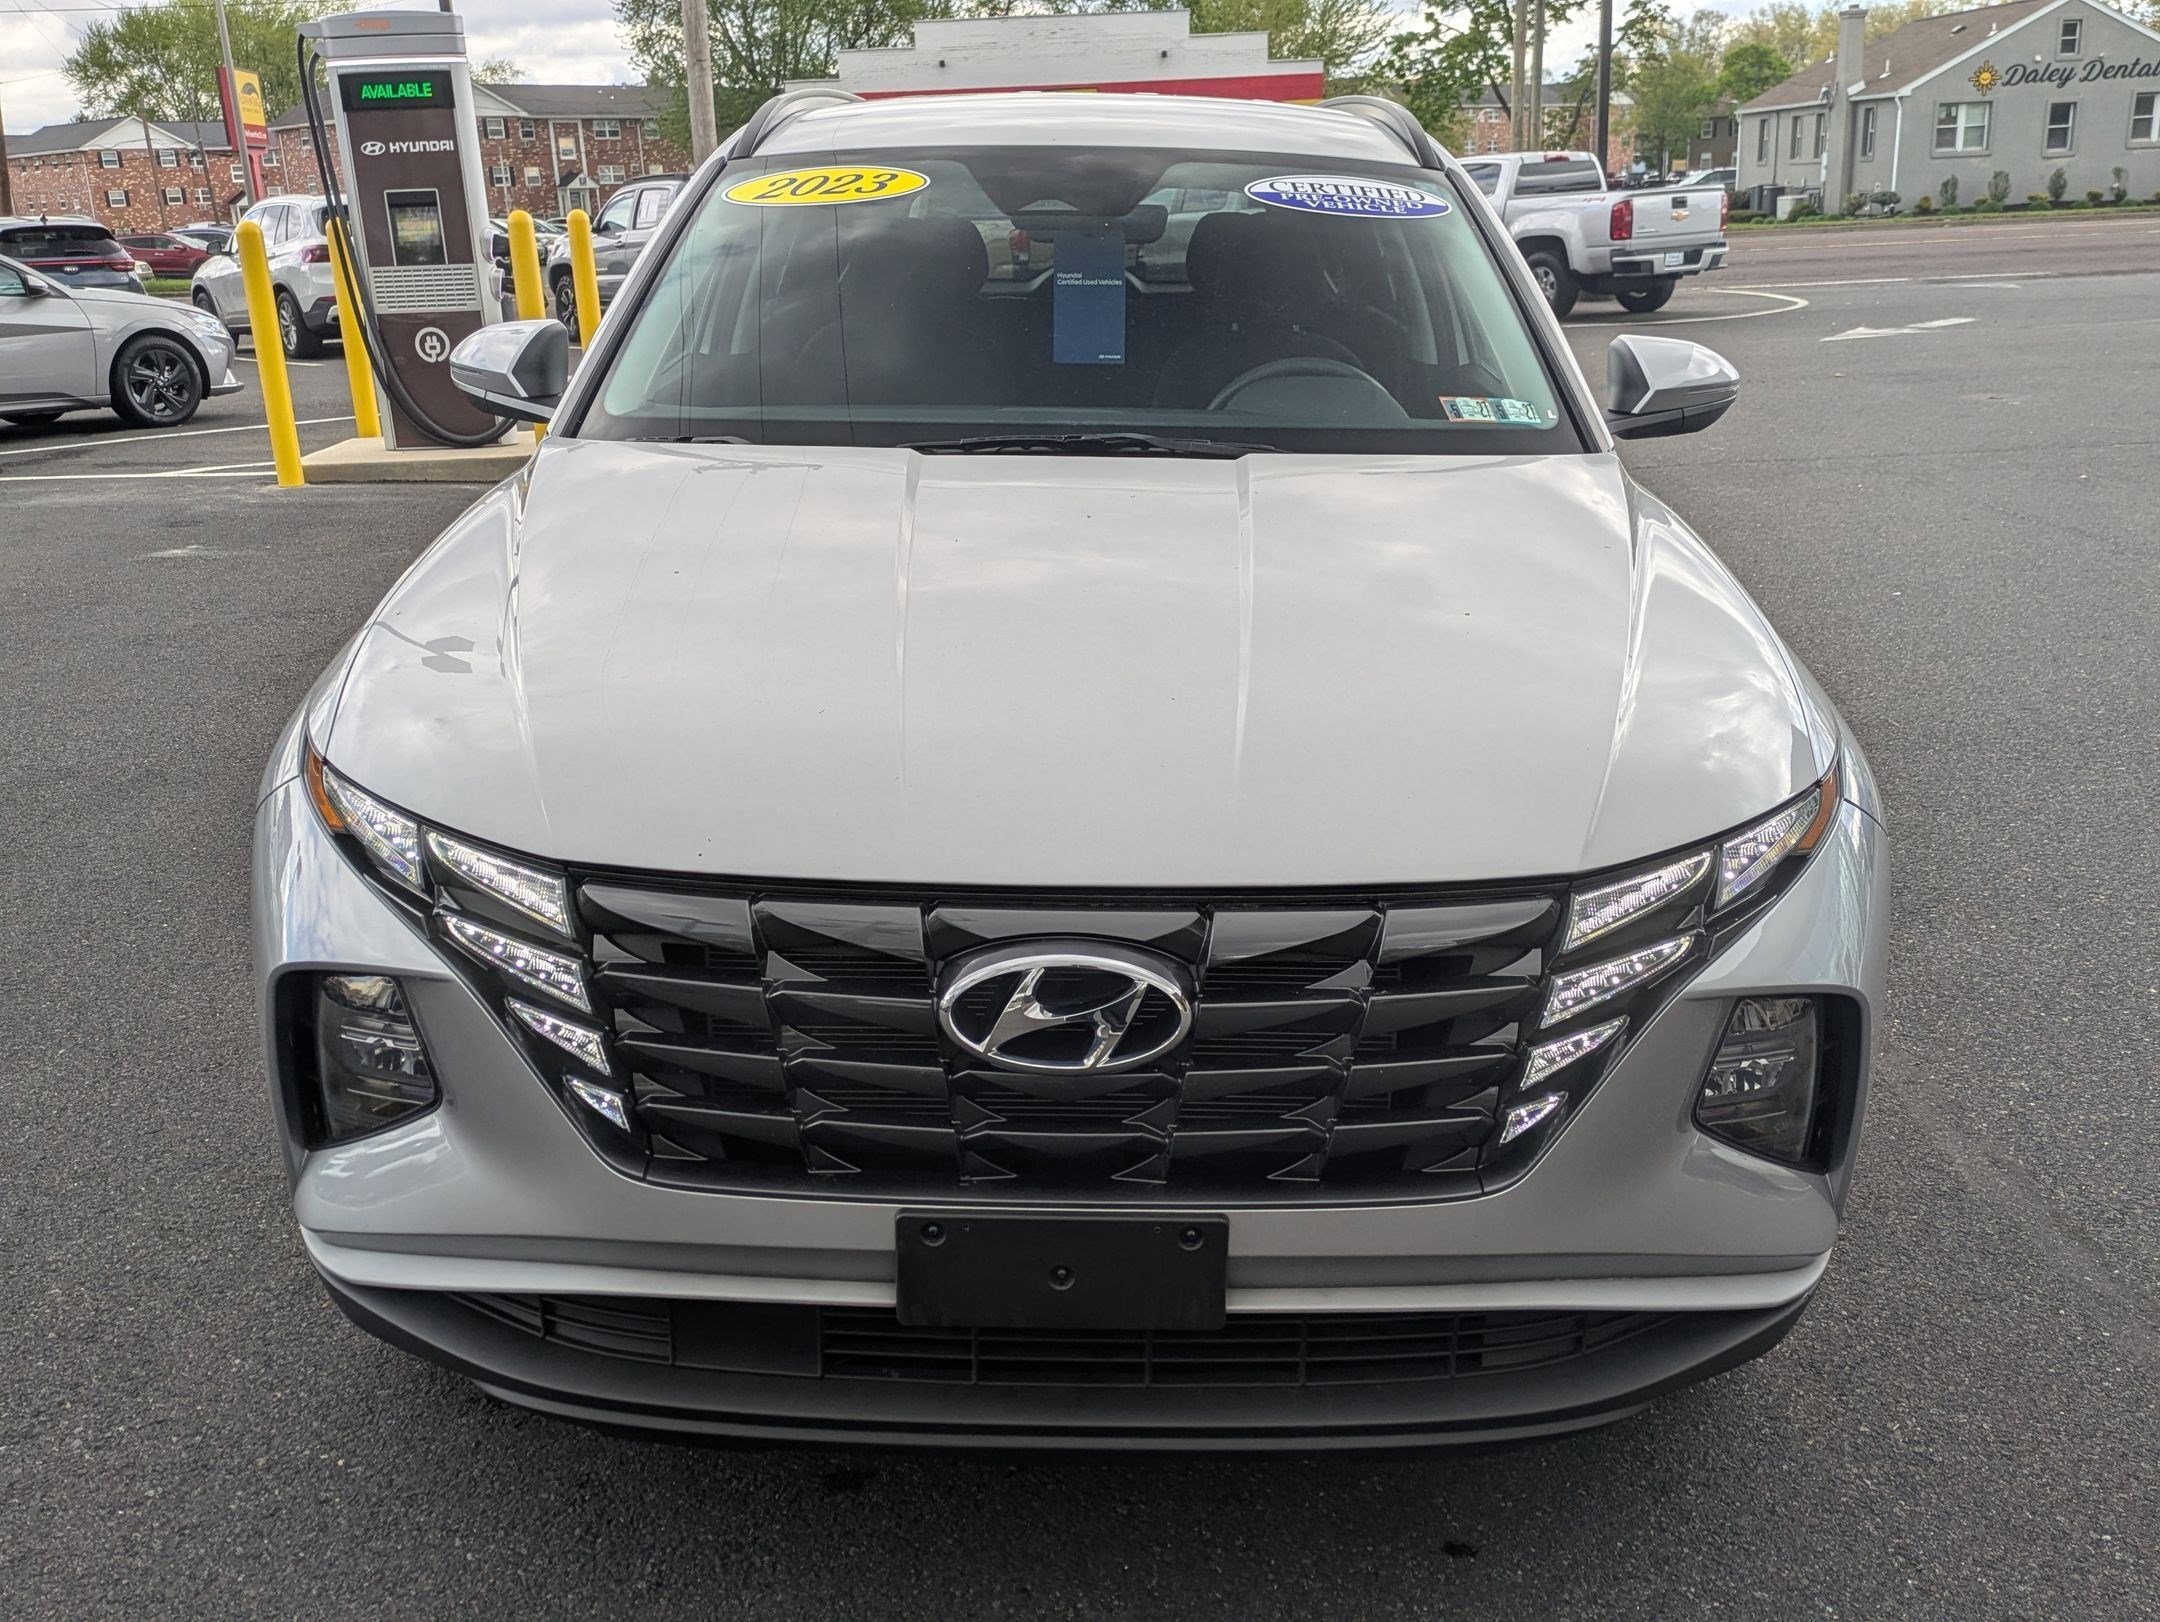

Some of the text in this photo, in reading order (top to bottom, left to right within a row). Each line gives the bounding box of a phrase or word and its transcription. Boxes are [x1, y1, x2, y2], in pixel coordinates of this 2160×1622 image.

[2001, 57, 2160, 89] Daley Dental
[361, 82, 433, 99] AVAILABLE
[389, 140, 454, 153] HYUNDAI
[752, 173, 899, 200] 2023
[1268, 180, 1425, 202] CERTIFIED
[1280, 192, 1423, 210] PRE-OWNED
[1303, 200, 1408, 214] VEHICLE
[1056, 271, 1083, 279] Hyundai
